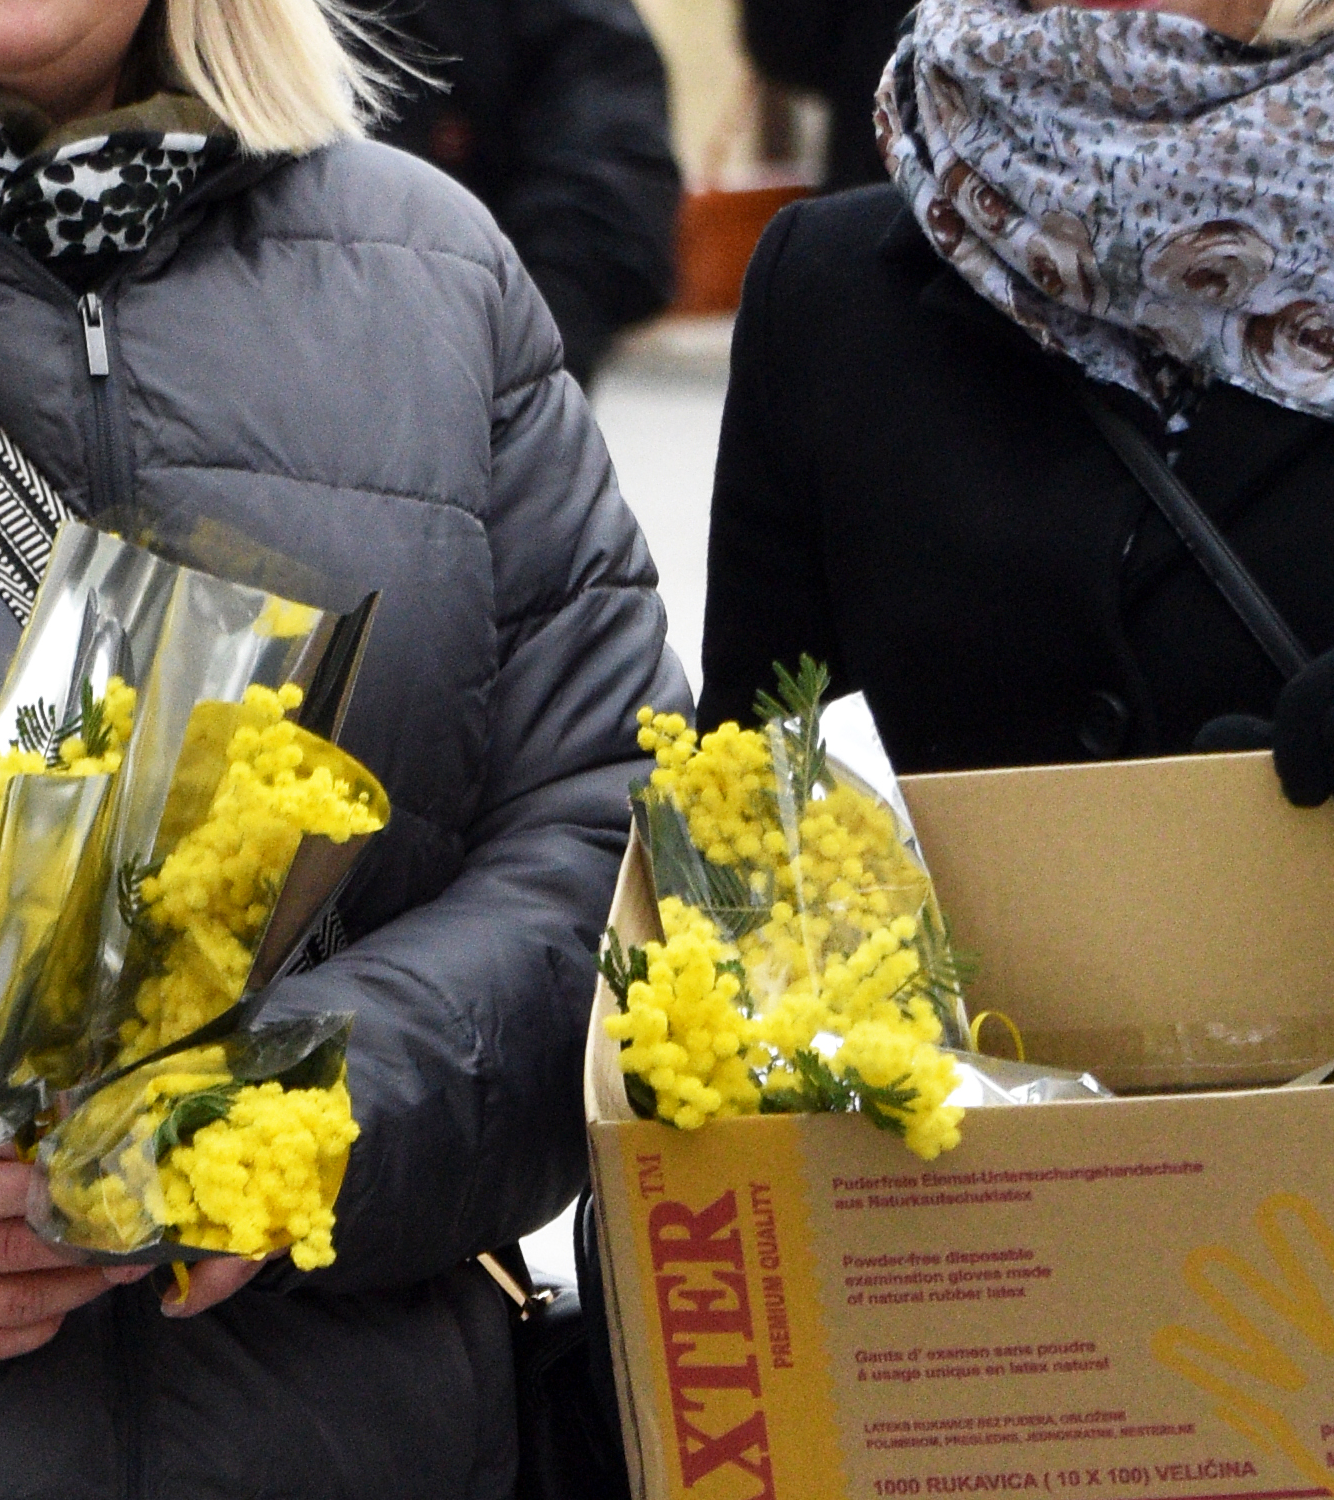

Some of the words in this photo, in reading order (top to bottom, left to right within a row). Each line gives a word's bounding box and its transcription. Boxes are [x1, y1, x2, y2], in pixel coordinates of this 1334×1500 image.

[835, 1197, 864, 1210] aus
[749, 1181, 780, 1272] QUALITY
[842, 1252, 941, 1269] Powder-free
[945, 1248, 1035, 1267] disposable
[845, 1270, 944, 1287] examination
[948, 1268, 1002, 1286] gloves
[1006, 1265, 1053, 1280] made
[847, 1291, 865, 1306] of
[868, 1288, 924, 1304] natural
[929, 1286, 982, 1301] rubber
[986, 1284, 1026, 1299] latex
[763, 1275, 793, 1369] PREMIUM
[855, 1348, 904, 1364] Gants
[927, 1346, 990, 1361] examen
[994, 1345, 1033, 1358] sans
[1037, 1340, 1096, 1358] poudre
[871, 1368, 921, 1383] usage
[925, 1364, 981, 1381] unique
[985, 1363, 1006, 1376] en
[1009, 1360, 1048, 1375] latex
[873, 1477, 920, 1496] 1000
[926, 1471, 1038, 1494] RUKAVICA
[1085, 1469, 1103, 1486] X
[1107, 1467, 1151, 1487] 100)
[1155, 1458, 1257, 1483] VELIČINA
